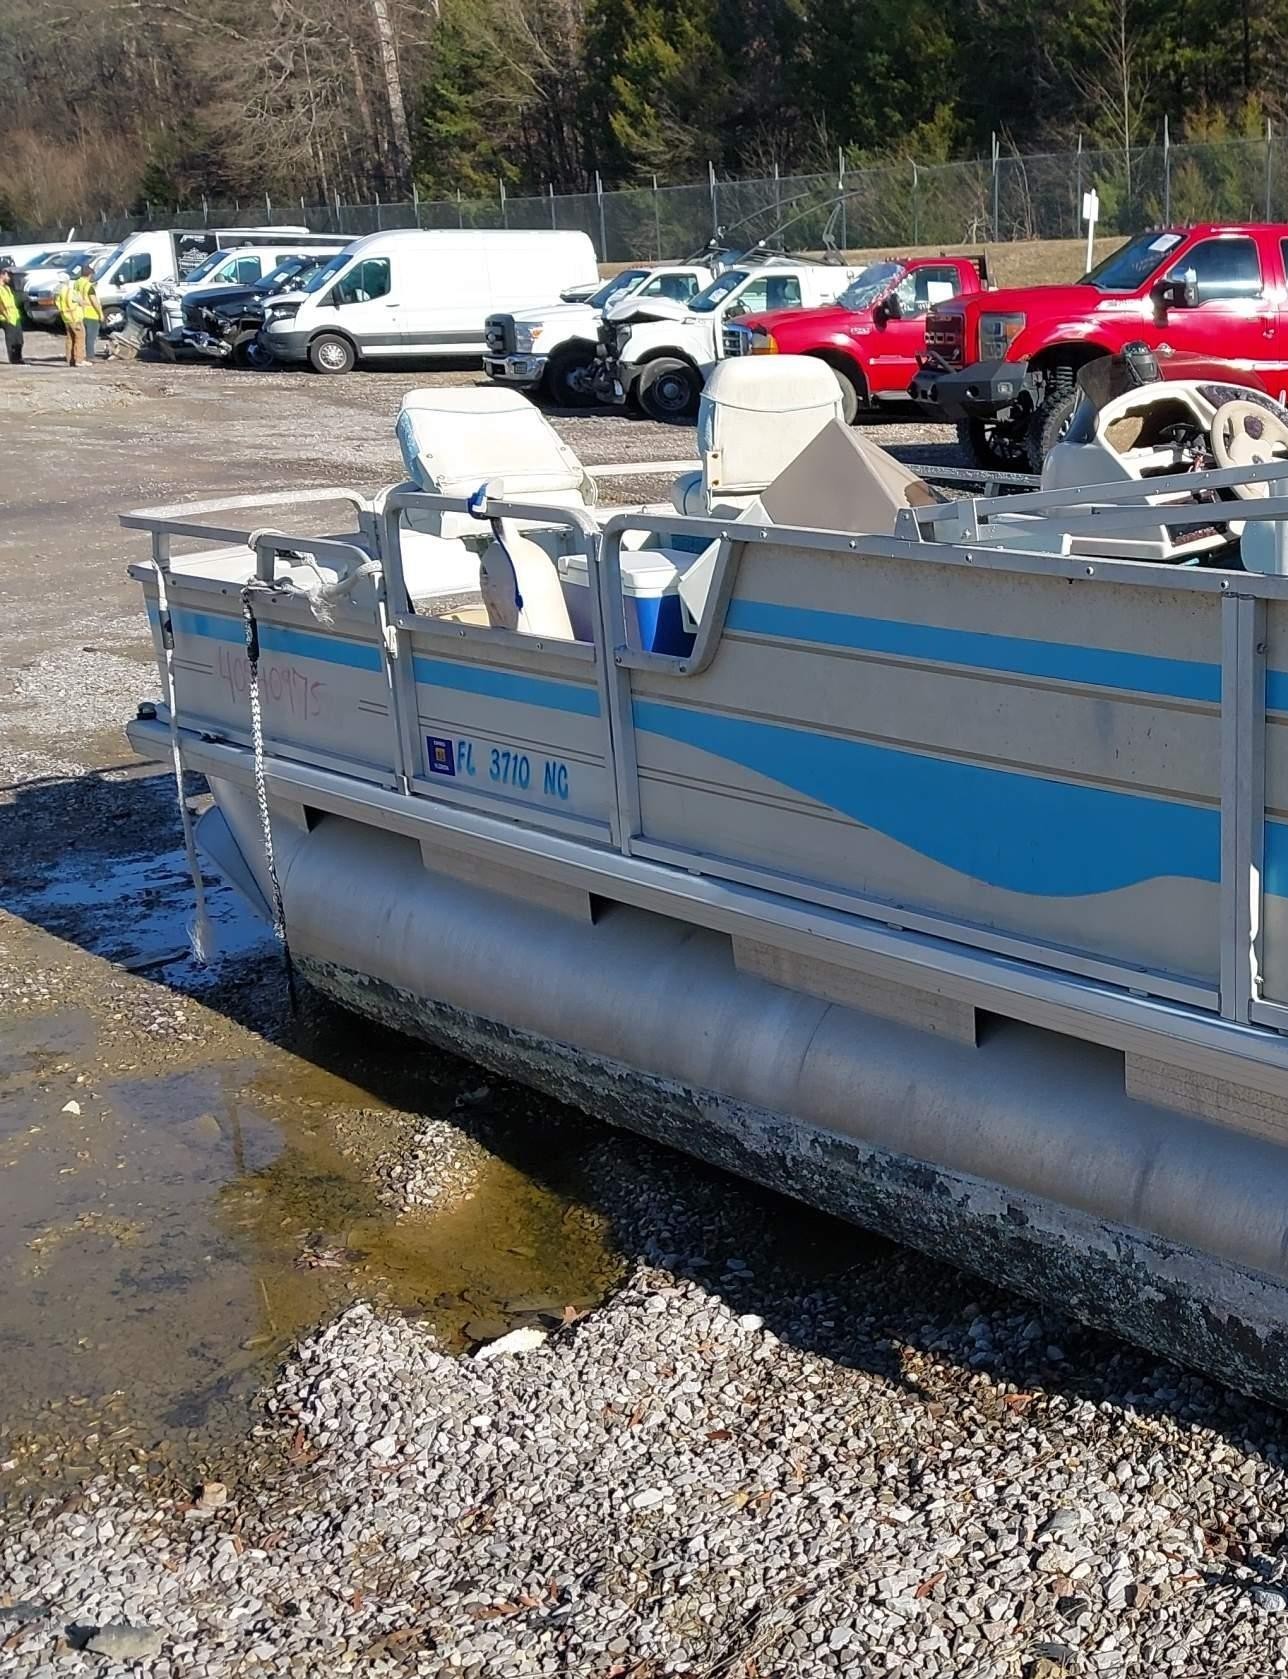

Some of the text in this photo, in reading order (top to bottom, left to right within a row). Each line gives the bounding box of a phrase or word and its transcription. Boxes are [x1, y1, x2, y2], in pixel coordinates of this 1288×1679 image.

[457, 740, 569, 800] FL 3710 NC
